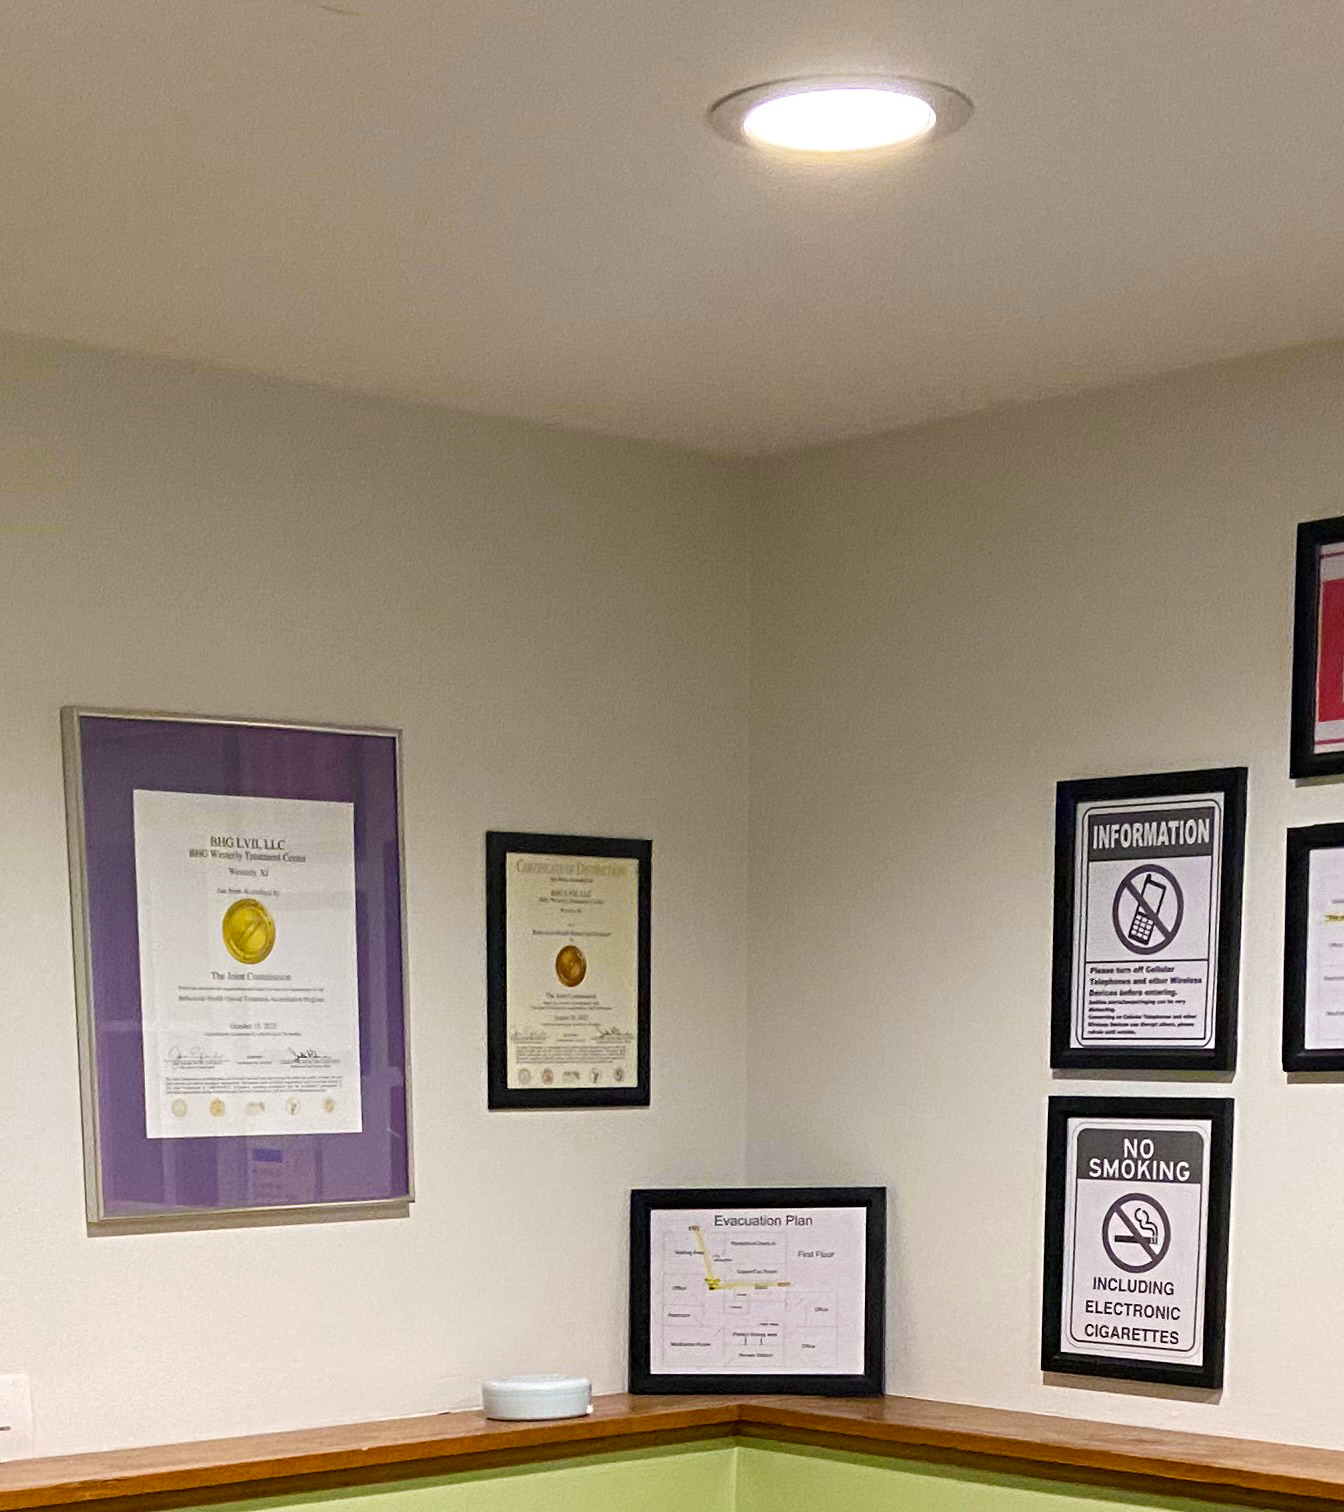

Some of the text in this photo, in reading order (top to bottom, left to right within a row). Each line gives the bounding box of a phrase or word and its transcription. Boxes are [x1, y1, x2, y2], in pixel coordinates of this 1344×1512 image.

[1092, 817, 1210, 850] INFORMATION
[210, 836, 234, 848] BHG
[264, 839, 286, 850] LLC
[210, 850, 243, 862] Westerly
[245, 851, 281, 861] Treatment
[282, 853, 306, 863] Center
[211, 971, 291, 981] The Joint Commission
[1133, 966, 1144, 974] off
[1090, 978, 1131, 986] Telephones
[1123, 1138, 1154, 1159] NO
[1088, 1158, 1191, 1182] SMOKING
[714, 1215, 813, 1227] Evacuation Plan
[798, 1250, 835, 1258] First Floor
[1092, 1276, 1175, 1296] INCLUDING
[1085, 1300, 1181, 1320] ELECTRONIC
[1084, 1323, 1180, 1344] CIGARETTES
